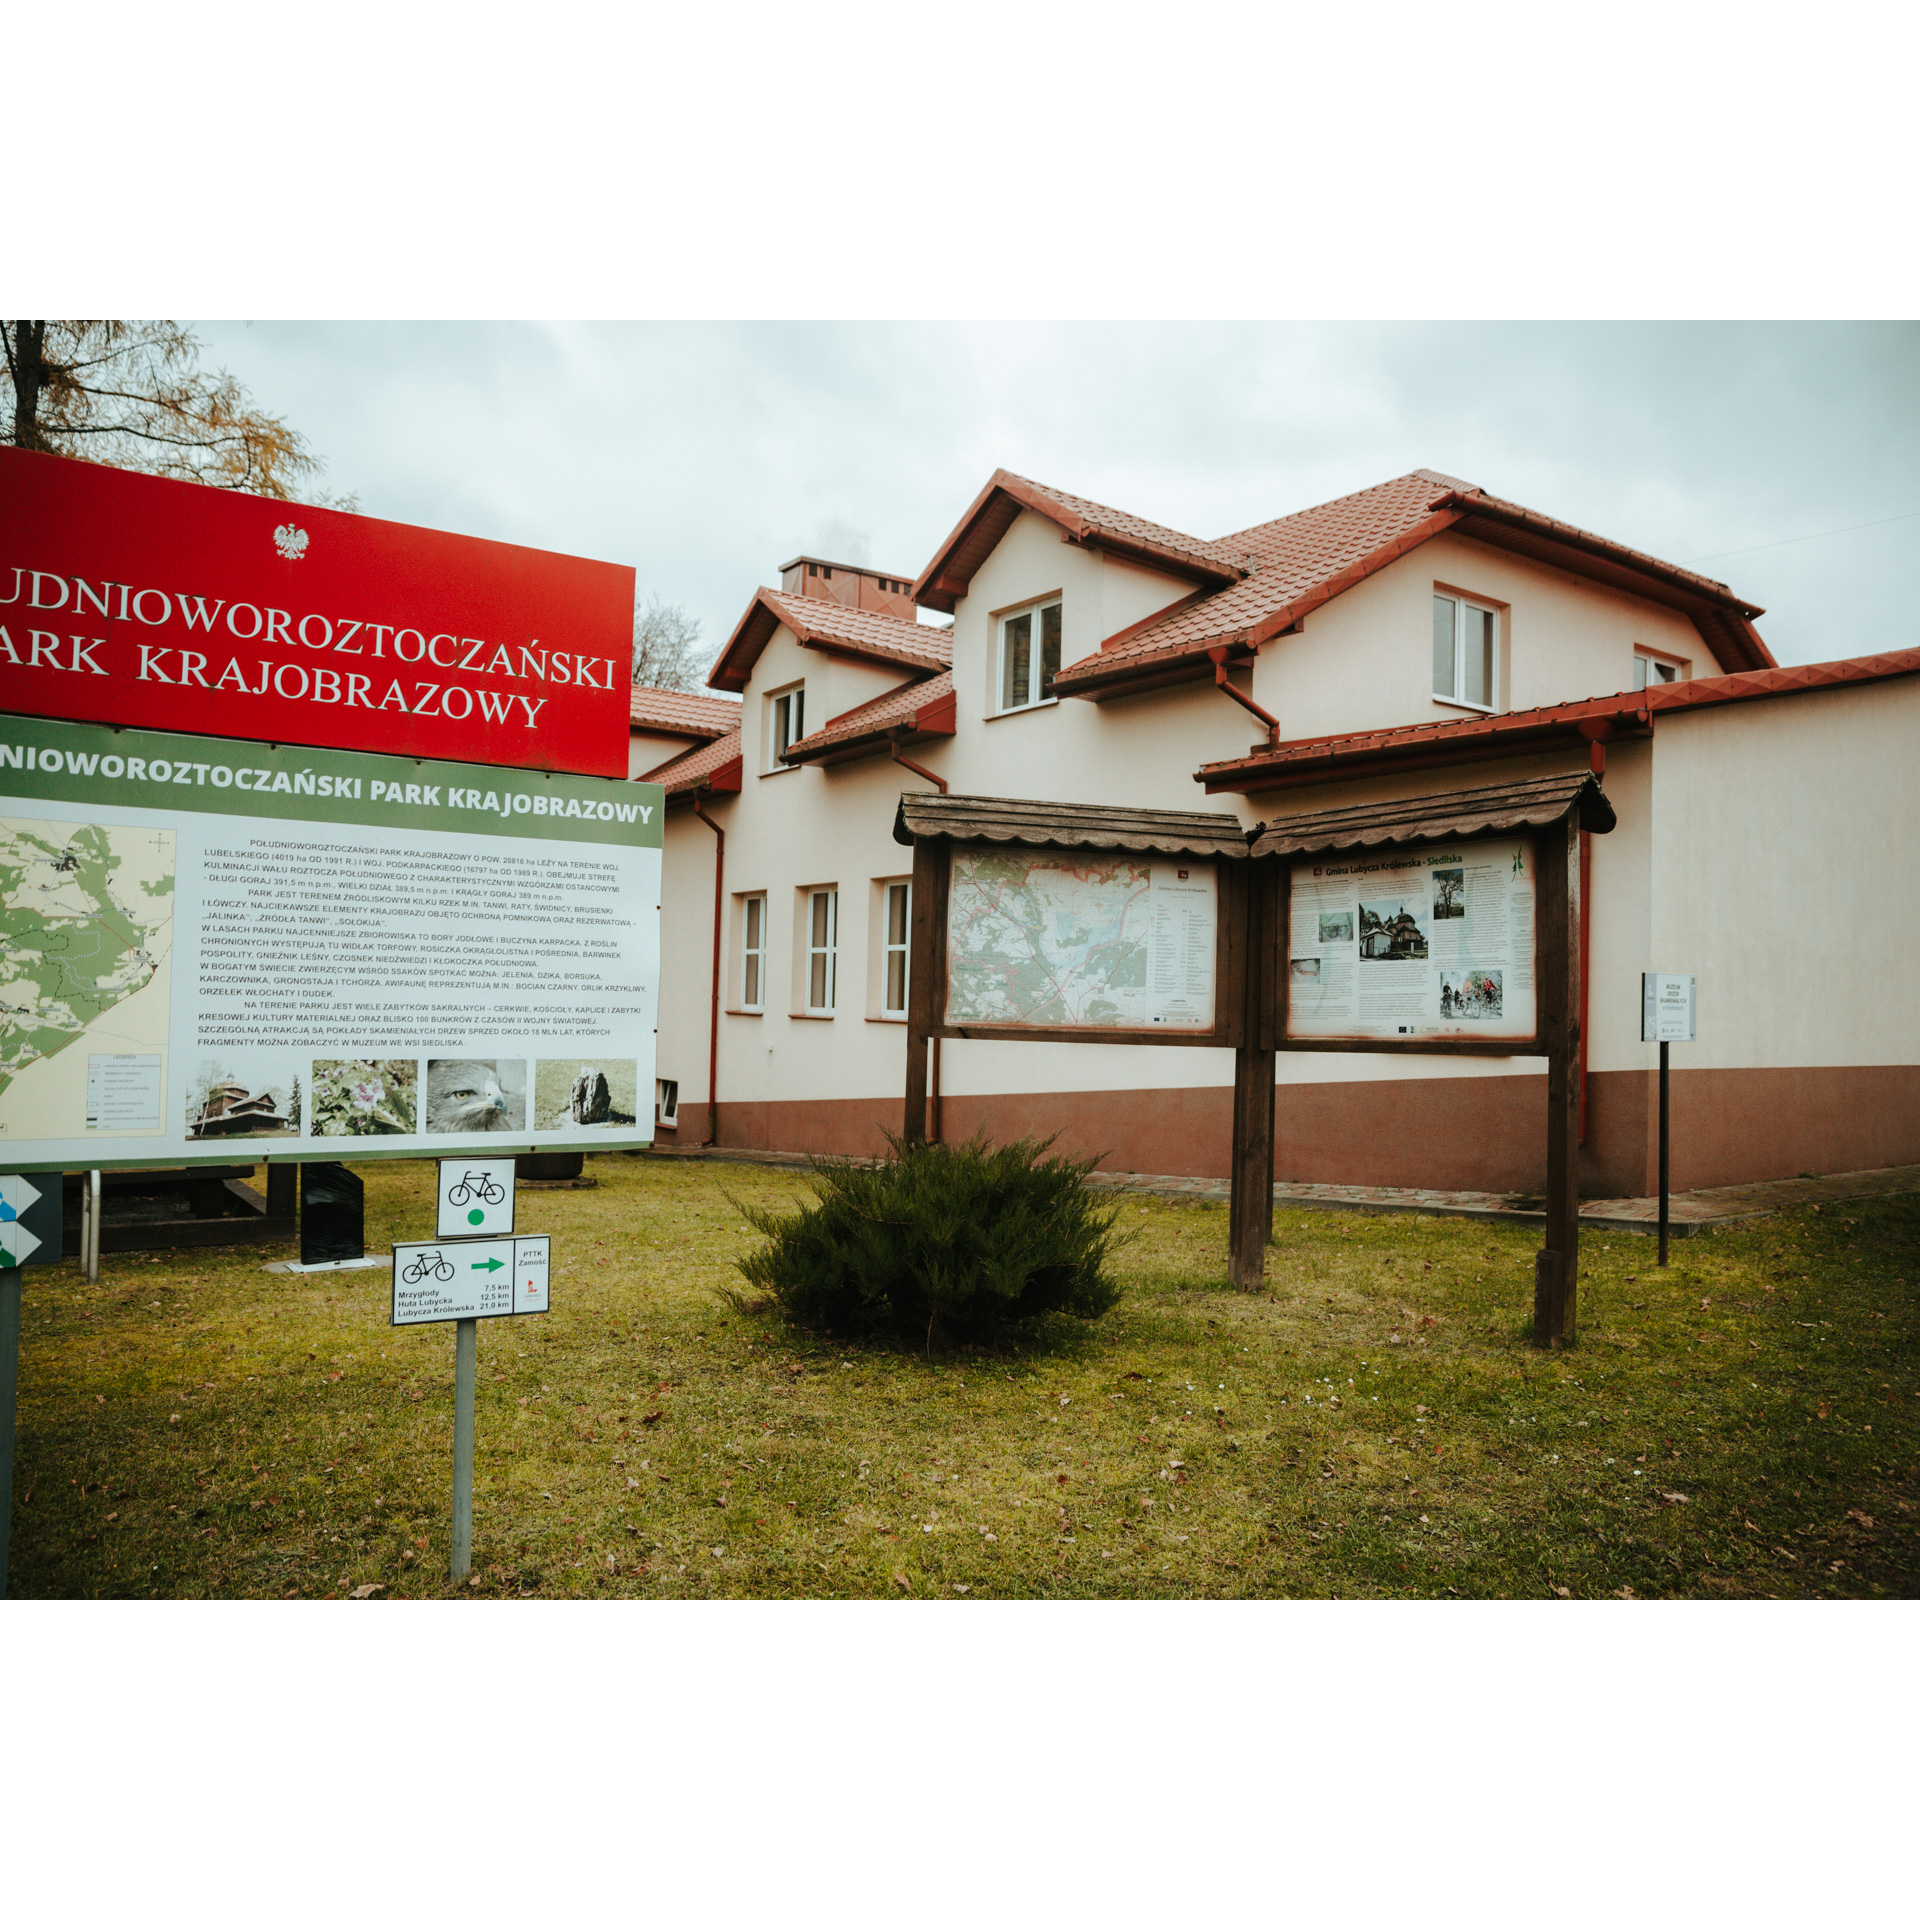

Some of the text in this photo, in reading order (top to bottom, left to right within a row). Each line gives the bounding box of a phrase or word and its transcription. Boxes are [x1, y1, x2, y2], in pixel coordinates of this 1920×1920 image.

[134, 644, 548, 729] KRAJOBRAZOWY
[370, 779, 441, 806] PARK
[448, 787, 653, 824] KRAJOBRAZOWY
[249, 839, 378, 855] POŁUDNIOWOROZTOCZAŃSKI
[379, 848, 401, 857] PARK
[403, 849, 472, 861] KRAJOBRAZOWY
[536, 856, 556, 867] LEŻY
[569, 860, 600, 870] TERENIE
[204, 848, 615, 884] LUBELSKIEGO PODKARPACKIEGO OBEJMUJE STREFĘ
[1326, 855, 1462, 876] Gmina Lubycza Królewska Siedliska
[203, 861, 619, 893] KULMINACJI WAŁU ROZTOCZA POŁUDNIOWEGO CHARAKTERYSTYCZNYMI WZGÓRZAMI OSTAŃCOWYMI
[208, 874, 237, 883] DŁUGI
[337, 882, 367, 891] WIELKI
[455, 888, 487, 898] KRĄGŁY
[247, 889, 272, 898] PARK
[274, 890, 296, 899] JEST
[299, 892, 341, 901] TERENEM
[412, 897, 437, 906] KILKU
[438, 899, 460, 907] RZEK
[574, 905, 613, 915] BRUSIENKI
[250, 902, 320, 912] NAJCIEKAWSZE
[322, 905, 368, 915] ELEMENTY
[369, 907, 425, 917] KRAJOBRAZU
[427, 910, 460, 920] OBJĘTO
[461, 912, 501, 923] OCHRONĄ
[502, 914, 552, 925] POMNIKOWĄ
[552, 916, 574, 925] ORAZ
[575, 917, 631, 929] REZERWATOWĄ
[212, 925, 250, 934] LASACH
[252, 927, 283, 935] PARKU
[285, 928, 356, 938] NAJCENNIEJSZE
[358, 931, 416, 941] ZBIOROWISKA
[430, 934, 453, 942] BORY
[455, 935, 494, 943] JODŁOWE
[500, 936, 537, 945] BUCZYNA
[590, 937, 617, 948] ROŚLIN
[200, 937, 269, 947] CHRONIONYCH
[271, 940, 325, 951] WYSTĘPUJĄ
[341, 942, 374, 951] WIDŁAK
[419, 945, 461, 954] ROSICZKA
[462, 946, 529, 956] OKRĄGŁOLISTNA
[582, 950, 621, 959] BARWINEK
[255, 950, 298, 961] GNIEŹNIK
[332, 954, 373, 963] CZOSNEK
[375, 954, 427, 964] NIEDŹWIEDZI
[433, 957, 483, 966] KŁOKOCZKA
[211, 963, 256, 972] BOGATYM
[258, 962, 296, 973] ŚWIECIE
[297, 965, 356, 976] ZWIERZĘCYM
[357, 965, 389, 975] WŚRÓD
[390, 966, 427, 976] SSAKÓW
[428, 968, 467, 978] SPOTKAĆ
[198, 988, 242, 996] ORZEŁEK
[244, 989, 295, 997] WŁOCHATY
[273, 977, 334, 986] GRONOSTAJA
[384, 979, 426, 990] AWIFAUNĘ
[428, 981, 491, 991] REPREZENTUJĄ
[515, 983, 545, 991] BOCIAN
[580, 984, 603, 992] ORLIK
[259, 1002, 297, 1010] TERENIE
[299, 1002, 329, 1010] PARKU
[354, 1003, 381, 1011] WIELE
[382, 1002, 429, 1012] ZABYTKÓW
[430, 1004, 485, 1012] SAKRALNYCH
[574, 1006, 606, 1014] KAPLICE
[198, 1013, 250, 1021] KRESOWEJ
[252, 1014, 293, 1022] KULTURY
[295, 1014, 356, 1022] MATERIALNEJ
[357, 1015, 381, 1023] ORAZ
[382, 1015, 414, 1023] BLISKO
[430, 1014, 472, 1024] BUNKRÓW
[480, 1014, 515, 1024] CZASÓW
[197, 1024, 260, 1036] SZCZEGÓLNĄ
[261, 1027, 310, 1036] ATRAKCJĄ
[326, 1027, 367, 1035] POKŁADY
[369, 1027, 436, 1035] SKAMIENIAŁYCH
[575, 1026, 610, 1036] KTÓRYCH
[256, 1036, 289, 1046] MOŻNA
[290, 1037, 339, 1046] ZOBACZYĆ
[518, 1257, 547, 1267] Zamość
[523, 1250, 543, 1258] PTTK
[398, 1289, 440, 1299] Mrzygłody
[485, 1284, 496, 1292] 7,5
[398, 1300, 417, 1308] Huta
[419, 1297, 453, 1307] Lubycka
[480, 1293, 496, 1302] 12,5
[397, 1308, 432, 1318] Lubycza
[433, 1304, 475, 1314] Królewska
[480, 1302, 496, 1310] 21,0
